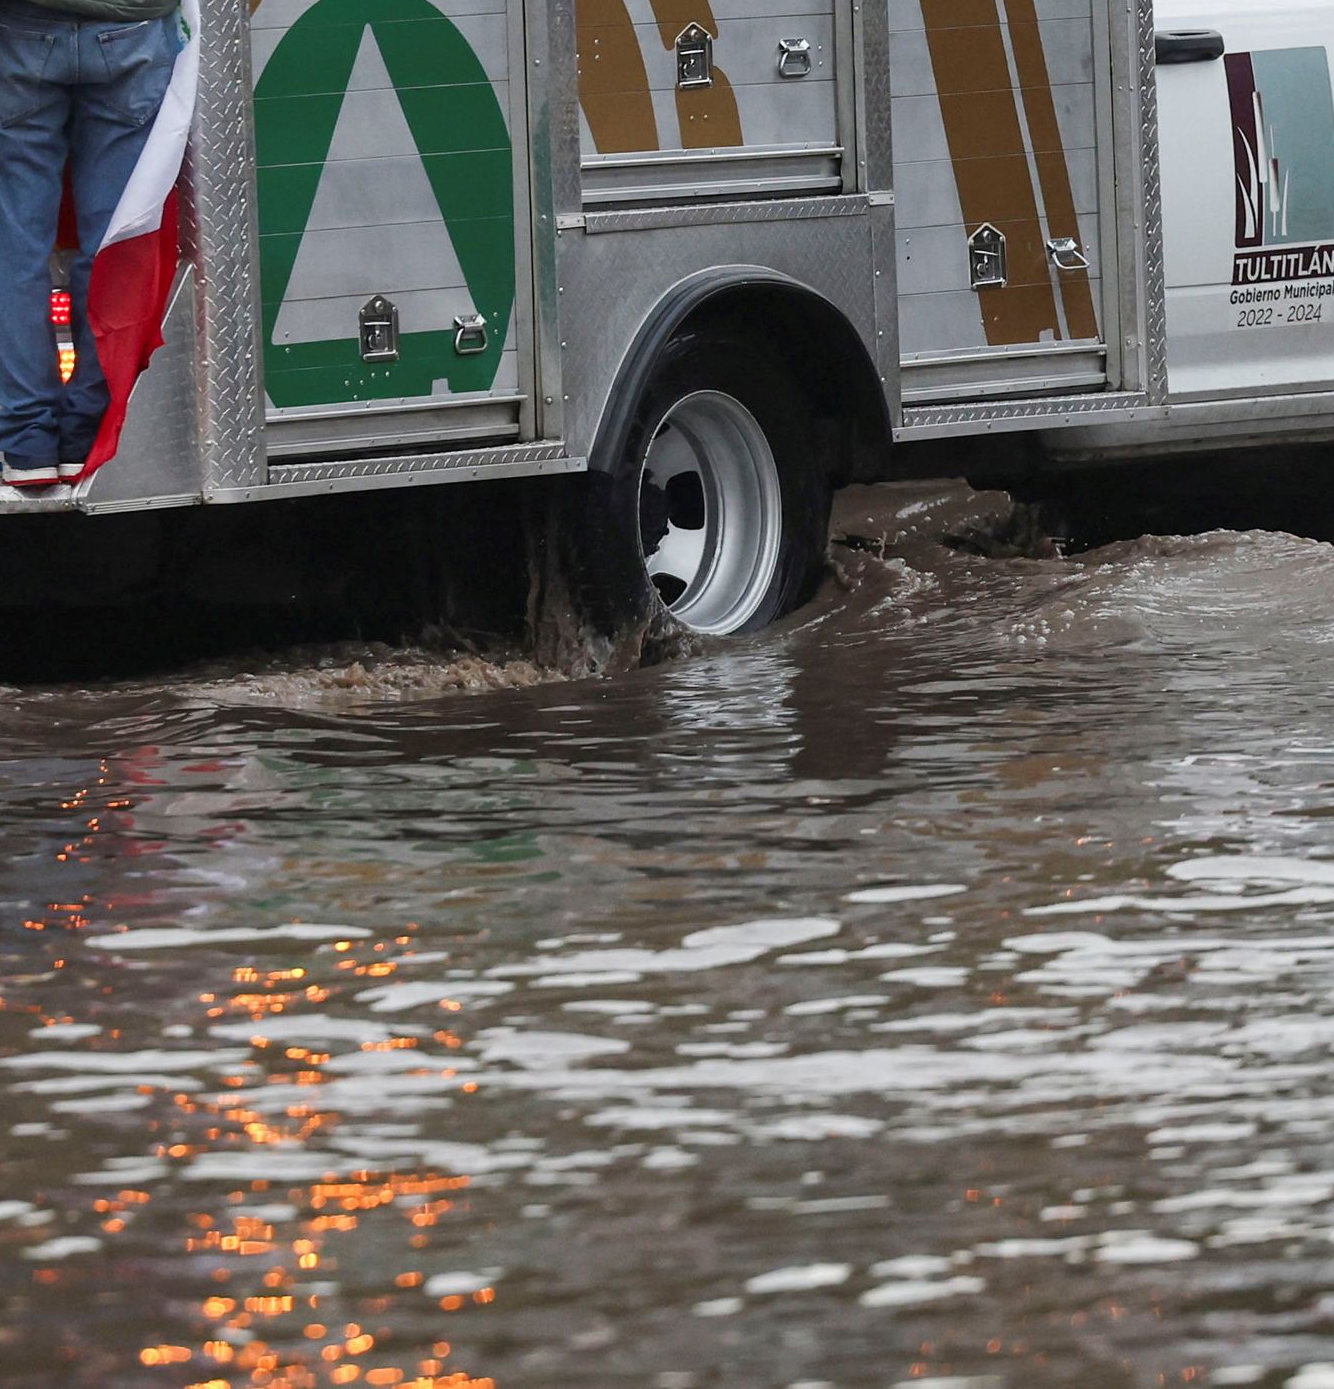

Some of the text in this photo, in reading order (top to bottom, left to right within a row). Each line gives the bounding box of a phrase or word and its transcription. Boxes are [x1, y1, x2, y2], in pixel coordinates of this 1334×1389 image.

[1229, 288, 1281, 305] Gobierno
[1237, 308, 1273, 327] 2022
[1287, 304, 1323, 323] 2024
